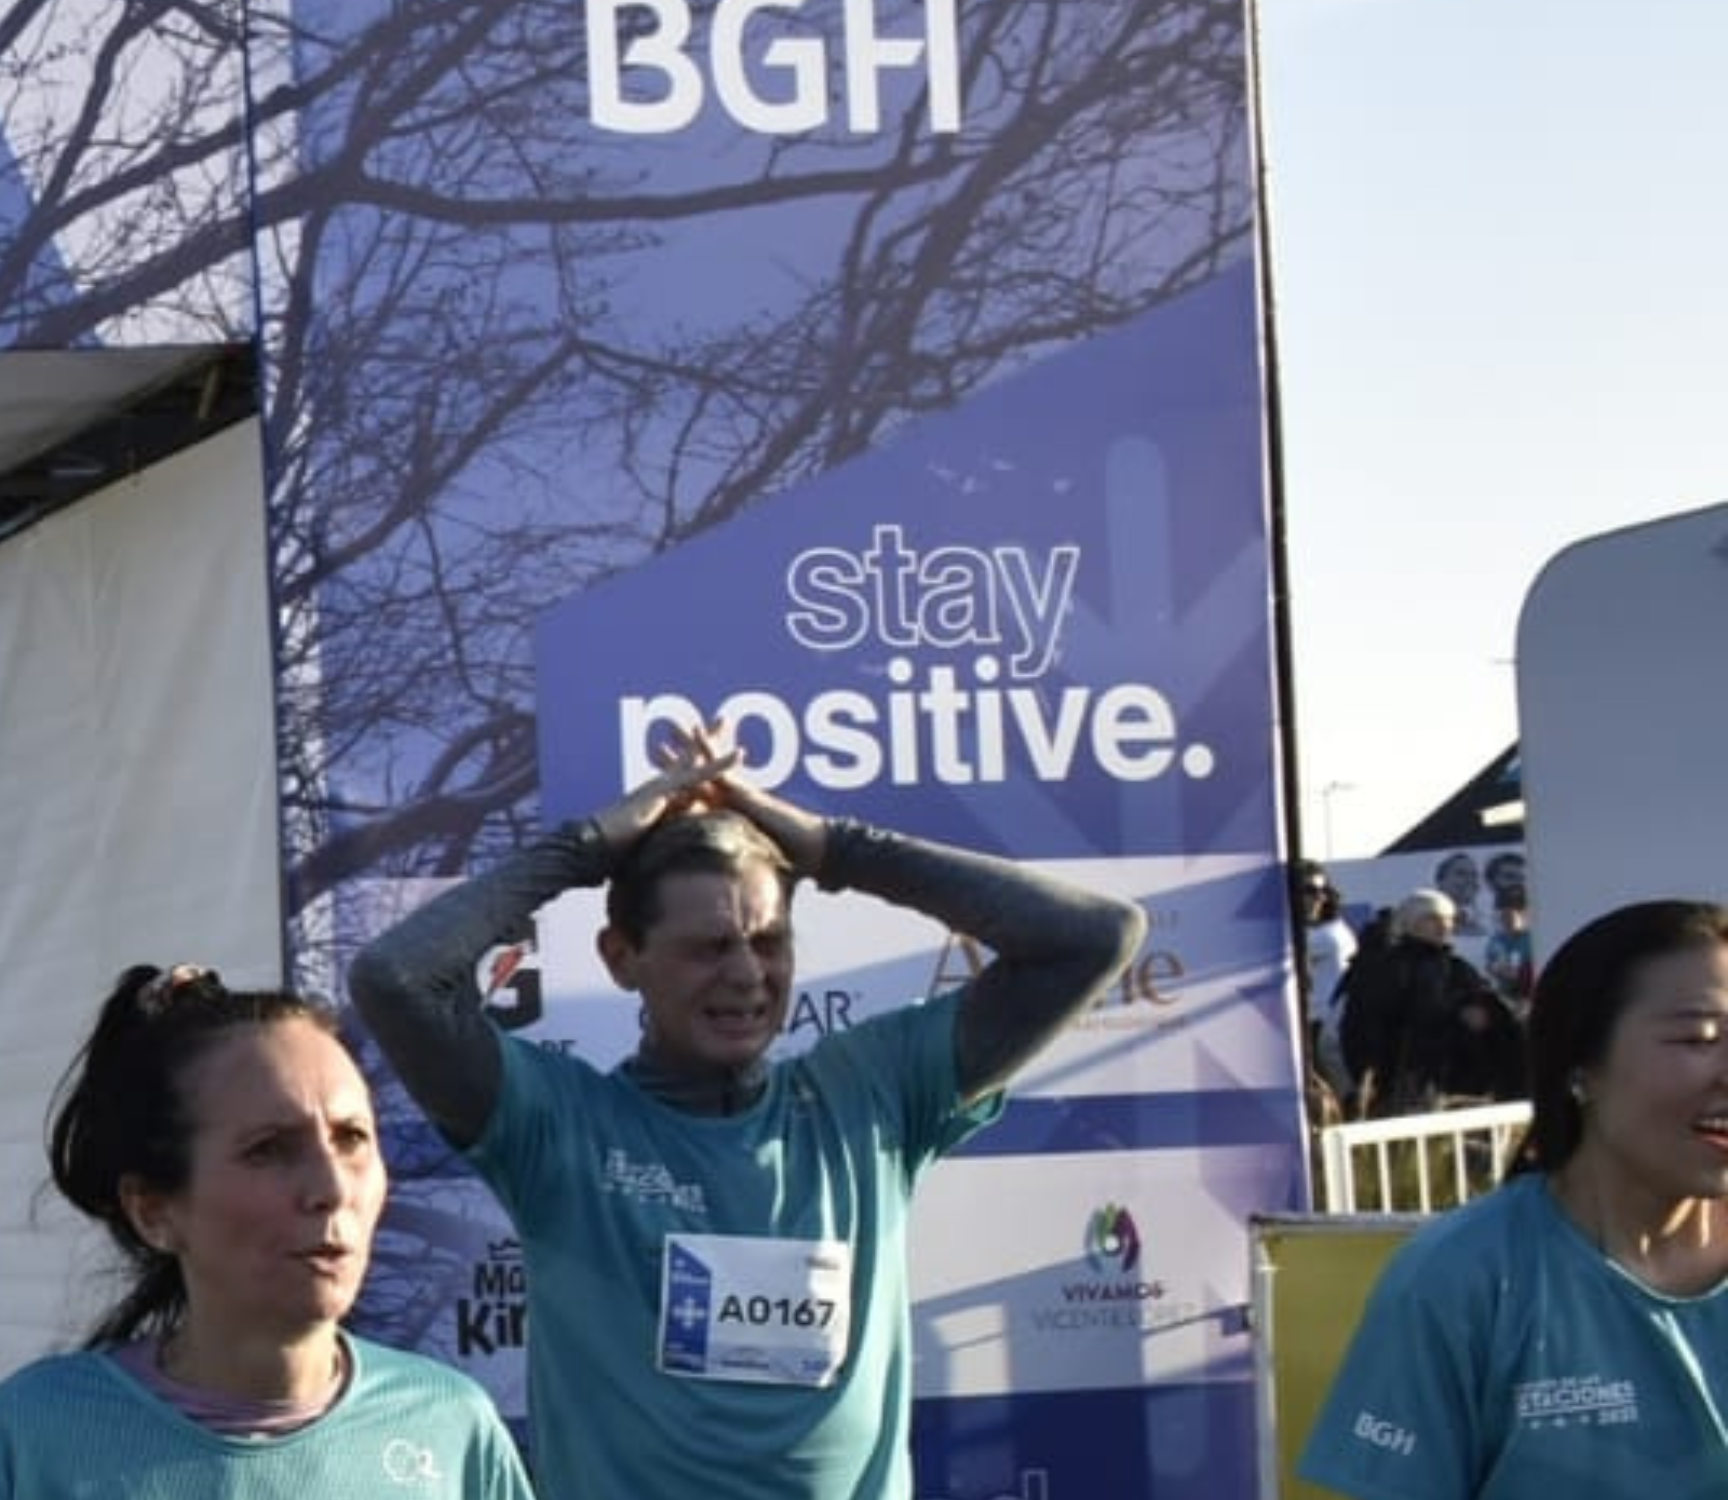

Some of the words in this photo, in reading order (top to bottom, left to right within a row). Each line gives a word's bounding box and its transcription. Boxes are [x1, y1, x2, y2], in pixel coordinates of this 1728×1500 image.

[588, 0, 963, 134] BGH
[787, 524, 1081, 678] stay
[620, 658, 1213, 794] positive.
[718, 1295, 835, 1326] A0167
[1354, 1412, 1417, 1455] BGH
